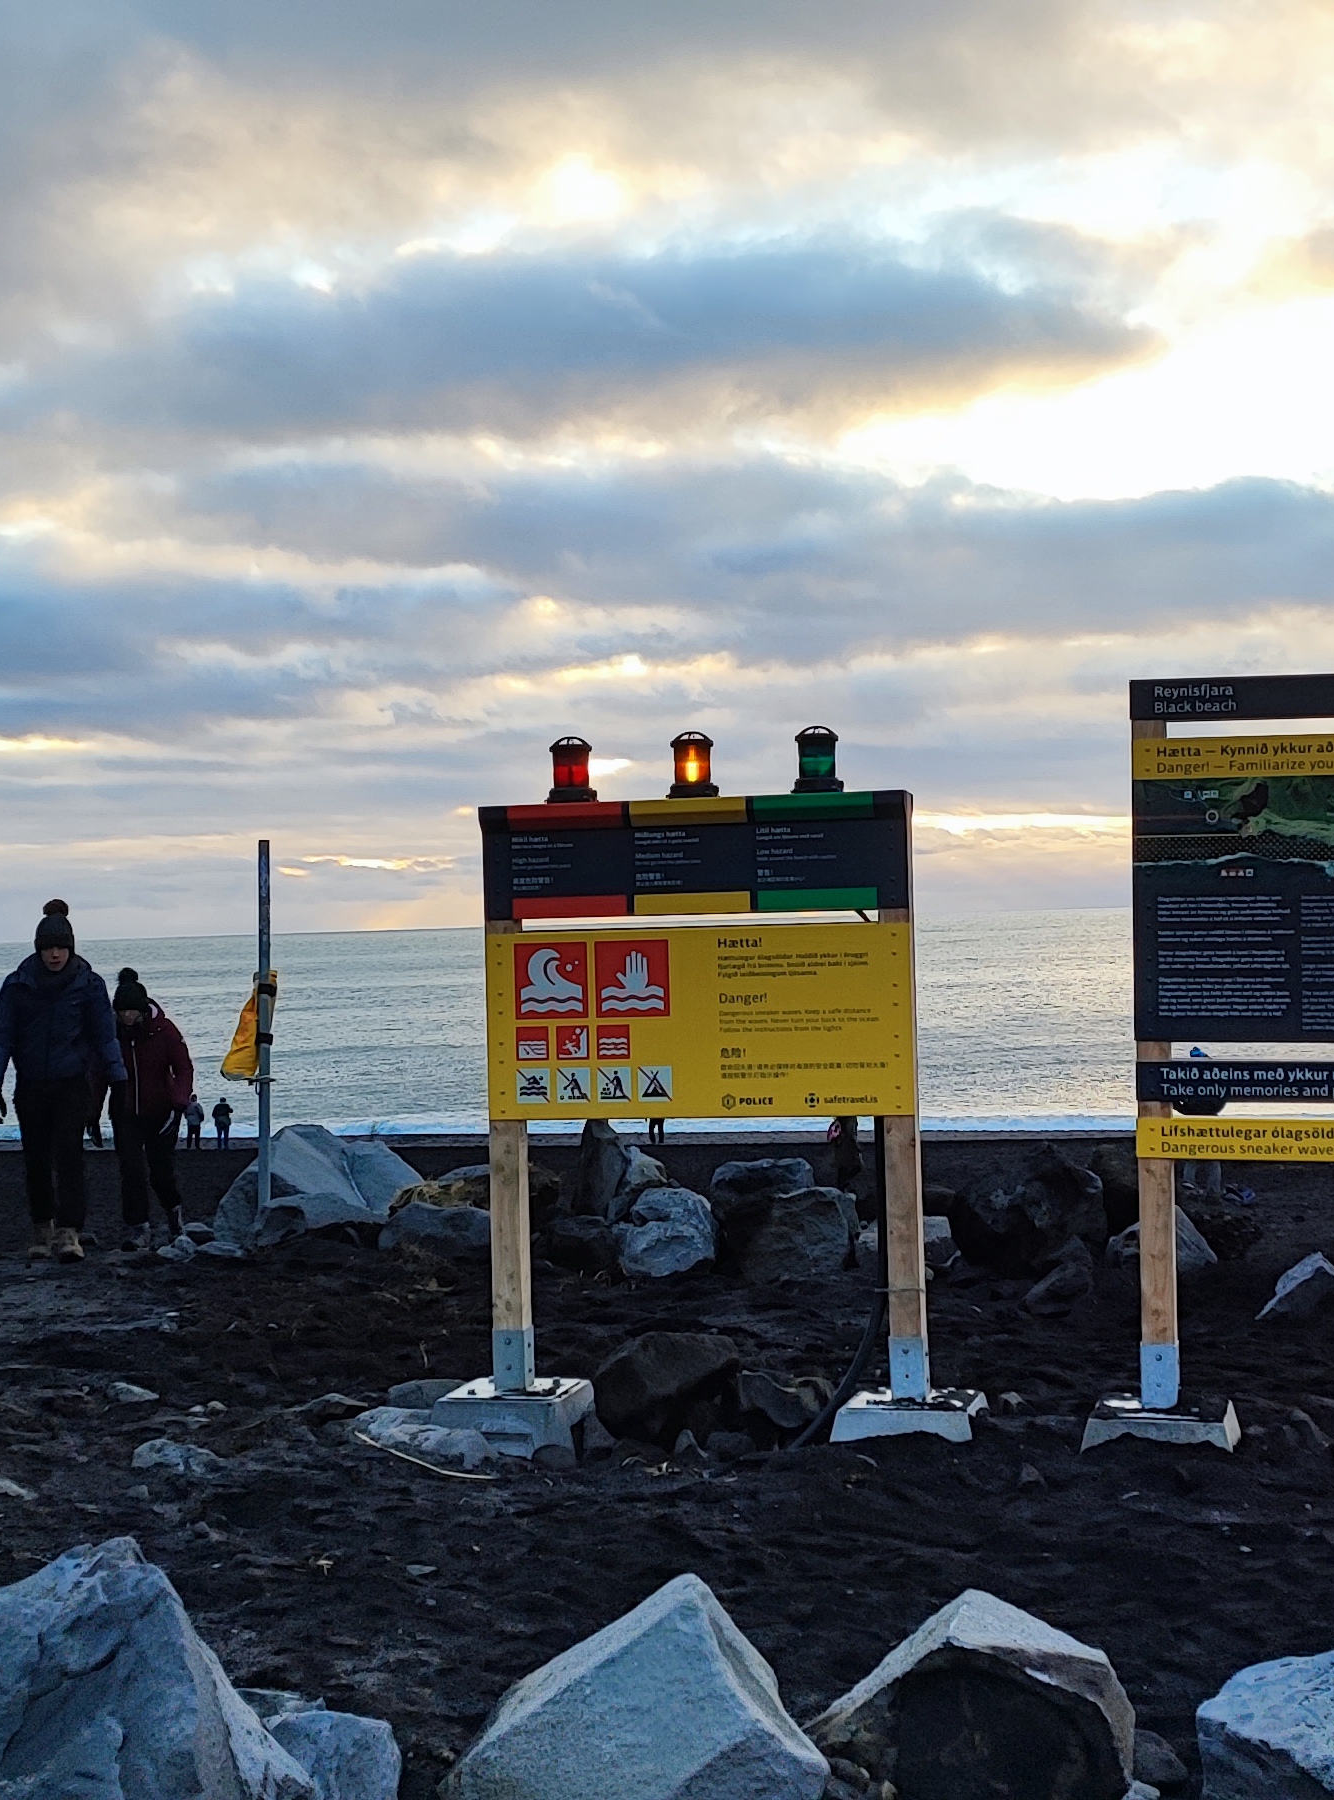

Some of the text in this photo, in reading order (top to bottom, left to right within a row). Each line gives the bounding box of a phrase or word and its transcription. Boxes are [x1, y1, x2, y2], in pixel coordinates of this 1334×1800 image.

[1154, 684, 1233, 699] Reynisfjara
[1154, 699, 1236, 713] Black beach
[1157, 747, 1201, 757] Hætta
[1221, 743, 1268, 757] Kynnið
[1272, 742, 1312, 756] ykkur
[1157, 762, 1209, 775] Danger!
[1229, 759, 1305, 771] Familiarize
[718, 937, 762, 948] Hætta!
[719, 993, 767, 1006] Danger!
[1160, 1067, 1199, 1080] Takið
[1203, 1068, 1249, 1080] aðeins
[1254, 1068, 1284, 1080] með
[1288, 1068, 1328, 1082] ykkur
[1161, 1084, 1194, 1095] Take
[1198, 1084, 1226, 1098] only
[1230, 1084, 1298, 1096] memories
[1302, 1084, 1328, 1096] and
[739, 1095, 878, 1105] POLICE safetravel.is
[1161, 1125, 1267, 1140] Lifshættulegar
[1161, 1142, 1235, 1155] Dangerous
[1240, 1143, 1293, 1155] sneaker
